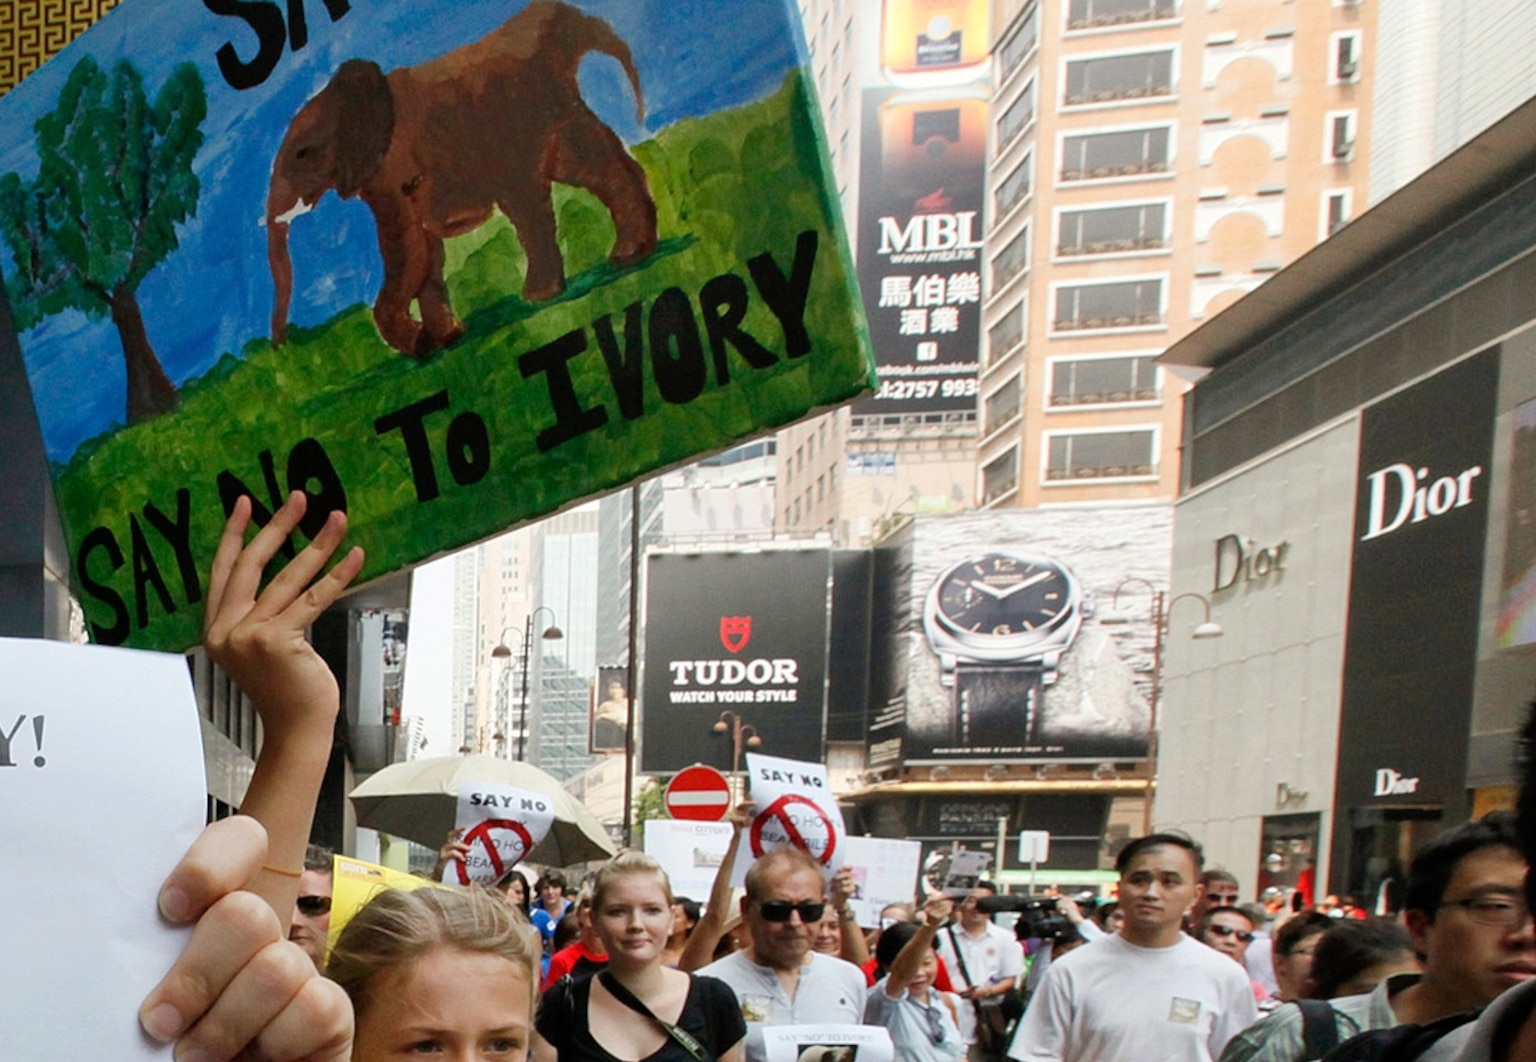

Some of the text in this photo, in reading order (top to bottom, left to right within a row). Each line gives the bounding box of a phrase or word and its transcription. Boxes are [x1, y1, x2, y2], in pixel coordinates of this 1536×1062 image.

[877, 211, 984, 254] MBL
[879, 272, 980, 308] 馬伯樂
[77, 487, 202, 646] SAY
[216, 437, 347, 562] NO
[517, 229, 819, 453] IVORY
[1361, 463, 1482, 541] Dior
[1212, 533, 1289, 594] Dior
[669, 659, 799, 685] TUDOR
[669, 689, 797, 703] WATCH YOUR STYLE
[760, 769, 822, 788] SAY NO
[1374, 768, 1419, 796] Dior
[470, 792, 547, 812] SAY NO
